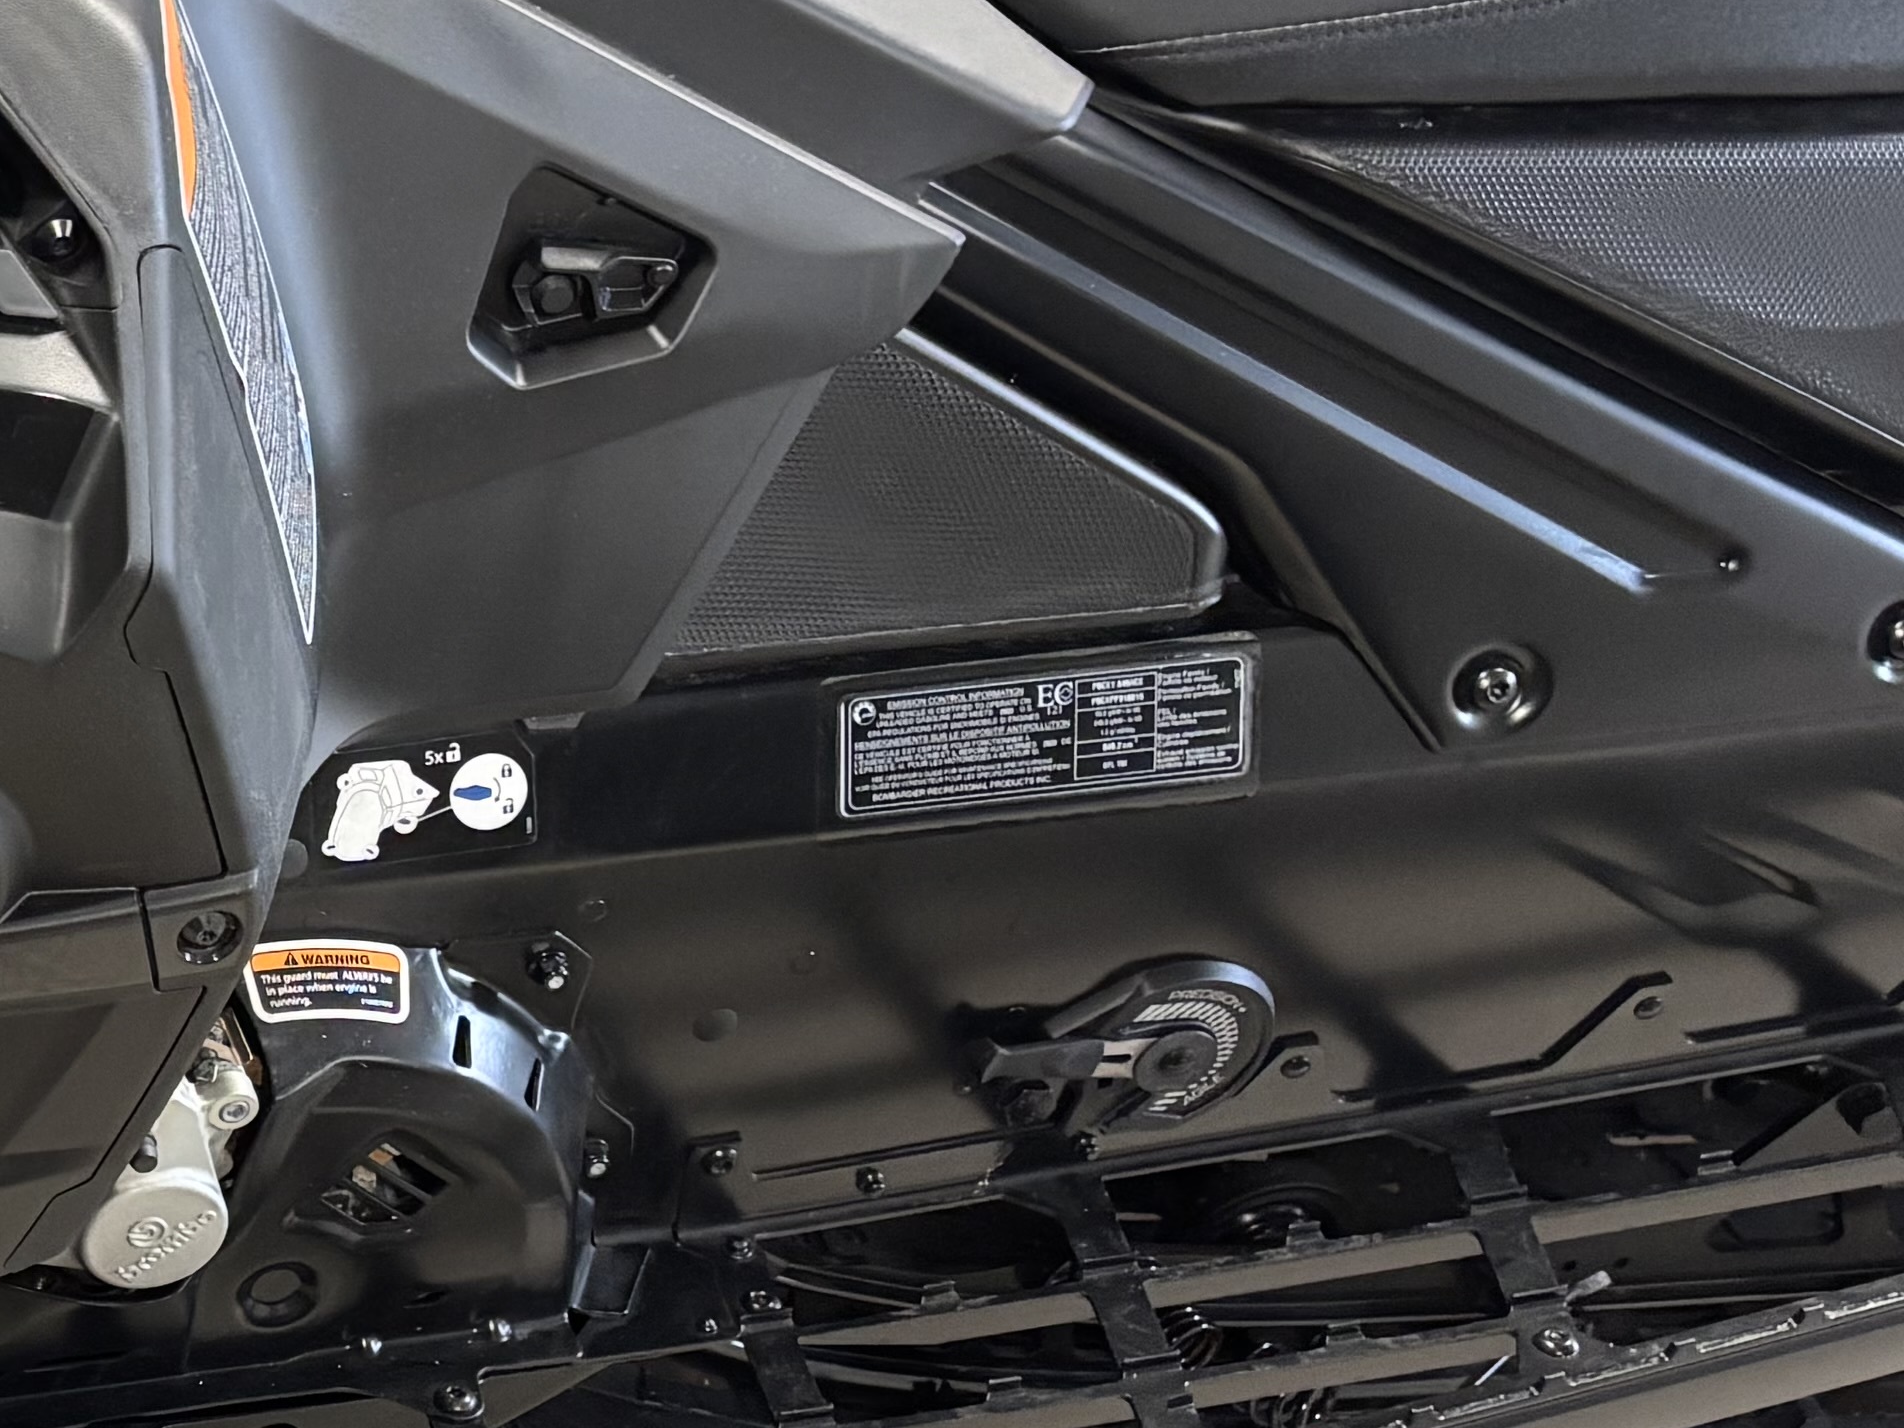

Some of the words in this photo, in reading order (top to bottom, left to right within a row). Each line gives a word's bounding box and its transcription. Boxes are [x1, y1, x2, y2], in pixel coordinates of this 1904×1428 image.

[424, 750, 444, 766] 5x
[301, 953, 370, 965] WARNING
[261, 973, 282, 984] This
[283, 971, 312, 984] guard
[342, 970, 379, 983] ALWAYS
[380, 972, 393, 984] be
[266, 986, 276, 996] in
[278, 984, 304, 997] place
[306, 982, 334, 992] when
[335, 983, 368, 995] engine
[270, 996, 313, 1008] running.
